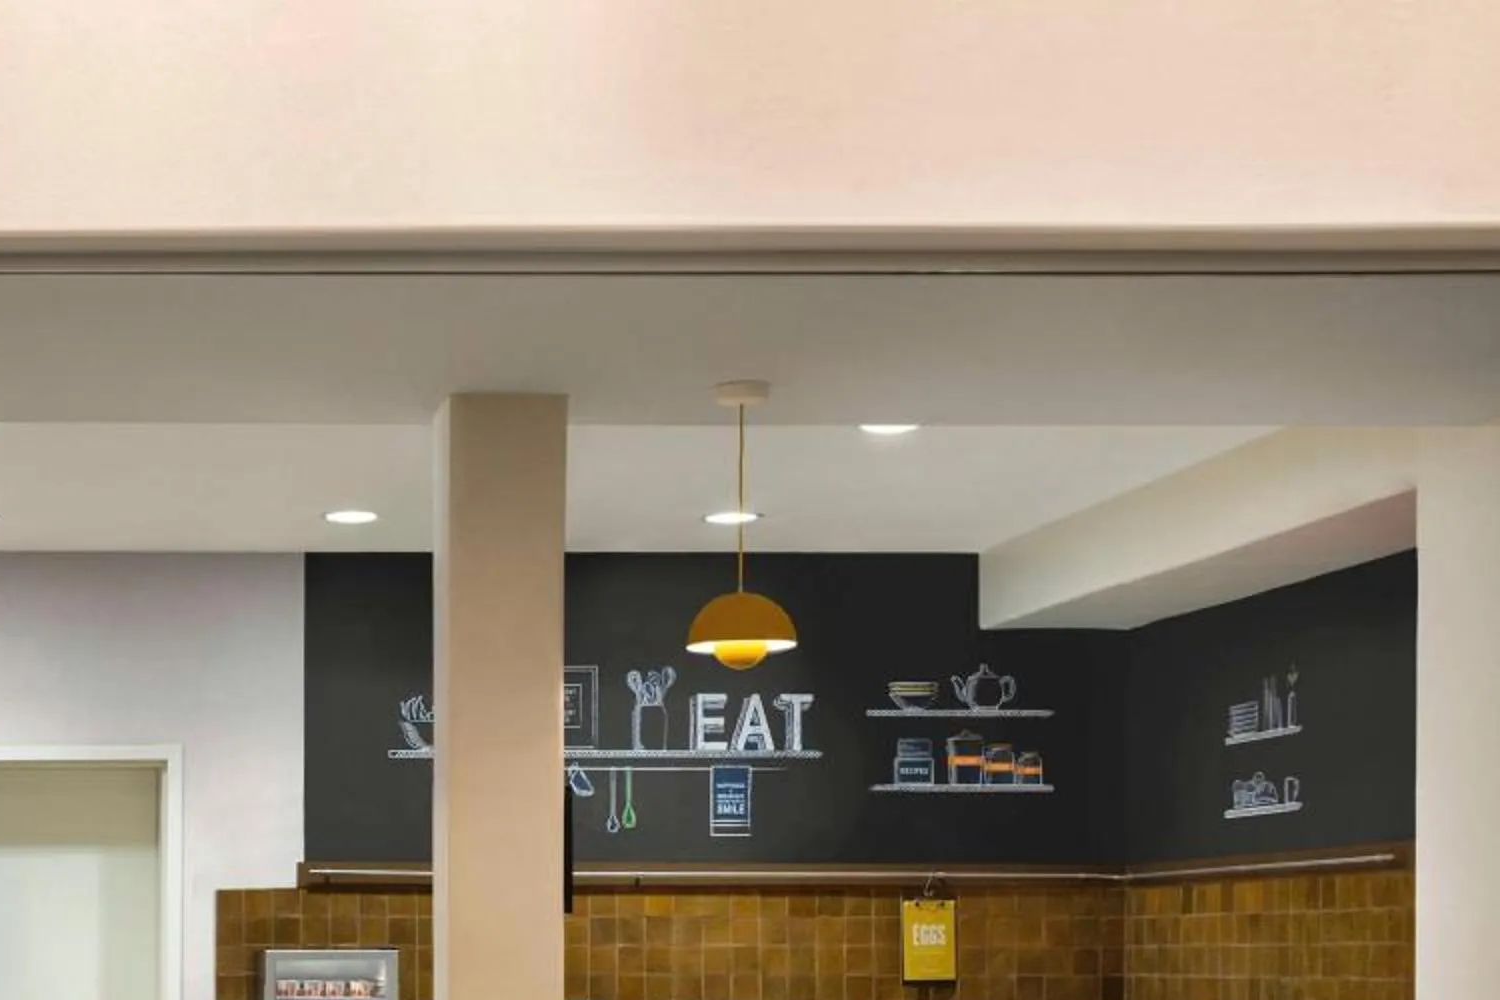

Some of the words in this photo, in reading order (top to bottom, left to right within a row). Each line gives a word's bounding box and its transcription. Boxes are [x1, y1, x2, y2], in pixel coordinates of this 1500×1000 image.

[689, 693, 815, 750] EAT
[716, 803, 745, 815] SMILE
[912, 923, 947, 946] EGGS
